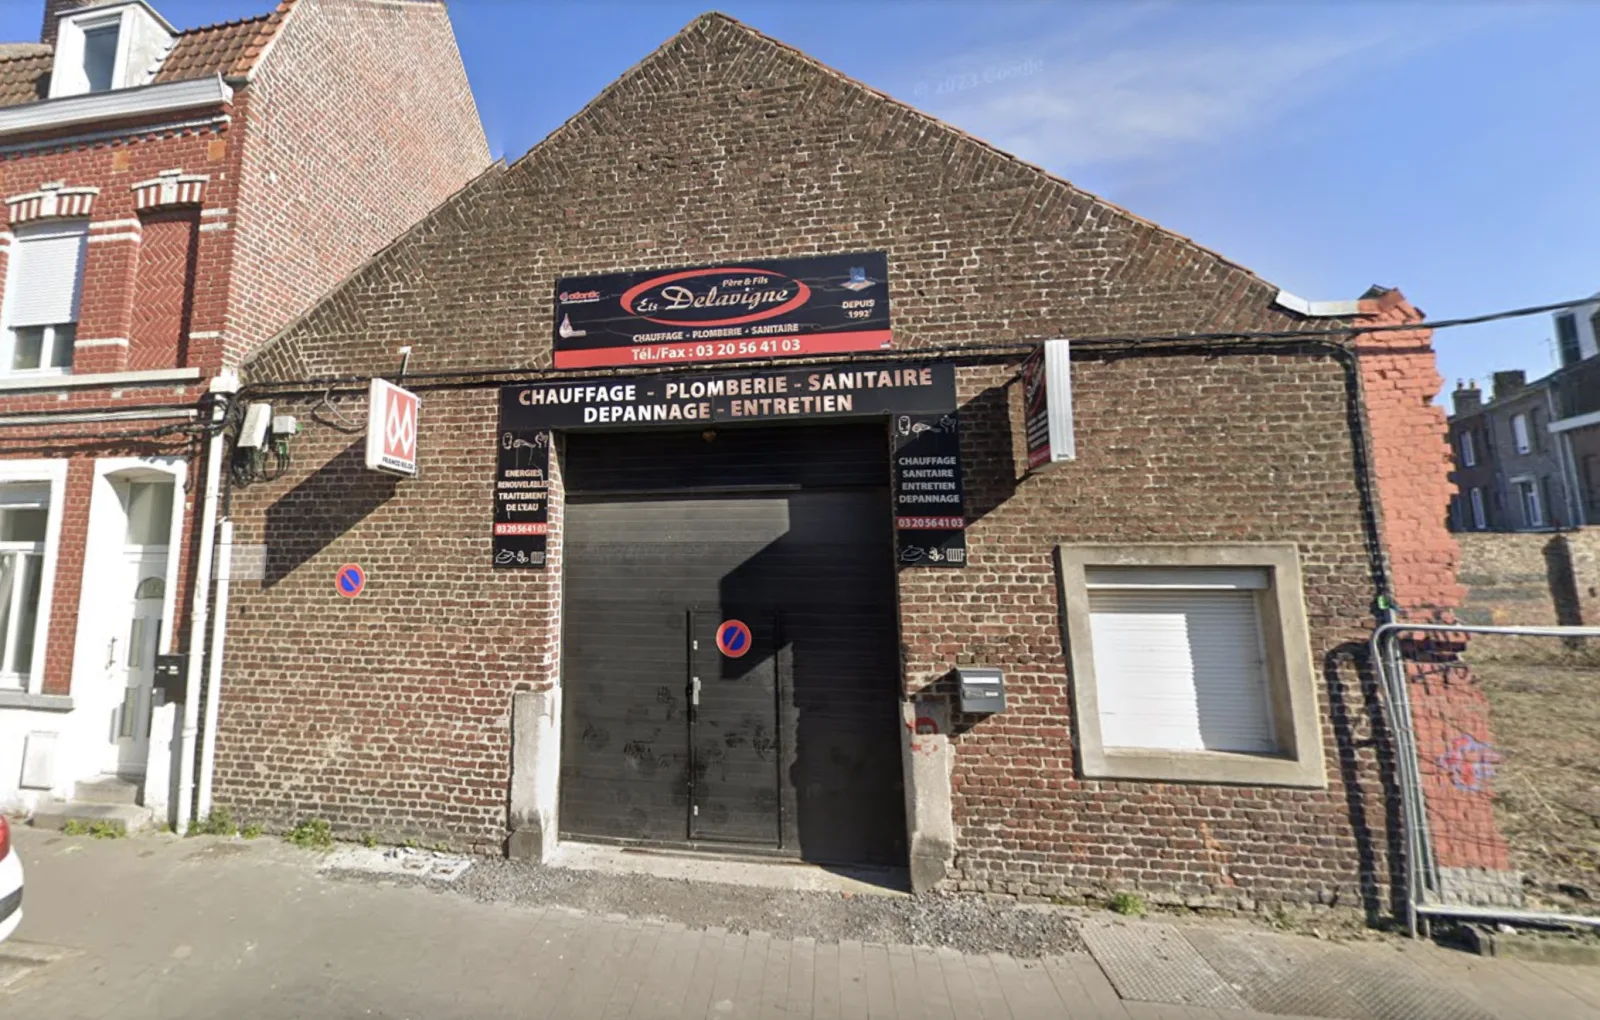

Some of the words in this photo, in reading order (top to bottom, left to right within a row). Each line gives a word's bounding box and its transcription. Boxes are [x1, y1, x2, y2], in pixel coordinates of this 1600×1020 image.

[723, 279, 743, 287] Père
[744, 278, 752, 286] &
[753, 277, 768, 286] Fils
[661, 285, 788, 311] Delavigne
[842, 299, 875, 309] DEPUIS
[848, 310, 870, 318] 1992
[633, 331, 683, 343] CHAUFFAGE
[692, 327, 742, 339] PLOMBERIE
[751, 323, 799, 335] SANITAIRE
[632, 346, 685, 361] Tél./Fax
[696, 344, 714, 357] 03
[717, 342, 736, 356] 20
[738, 341, 757, 355] 56
[760, 340, 777, 353] 41
[782, 338, 801, 352] 03
[519, 385, 636, 406] CHAUFFAGE
[666, 376, 788, 399] PLOMBERIE
[808, 368, 933, 391] SANITAIRE
[583, 402, 710, 423] DEPANNAGE
[731, 394, 853, 417] ENTRETIEN
[899, 456, 957, 466] CHAUFFAGE
[505, 469, 542, 477] ENERGIES
[902, 469, 954, 478] SANITAIRE
[901, 481, 956, 491] ENTRETIEN
[498, 492, 547, 500] TRAITEMENT
[899, 494, 960, 504] DEPANNAGE
[517, 503, 539, 511] L'EAU
[899, 518, 911, 528] 03
[913, 518, 924, 528] 20
[925, 518, 937, 528] 56
[938, 518, 949, 528] 41
[951, 518, 964, 528] 03
